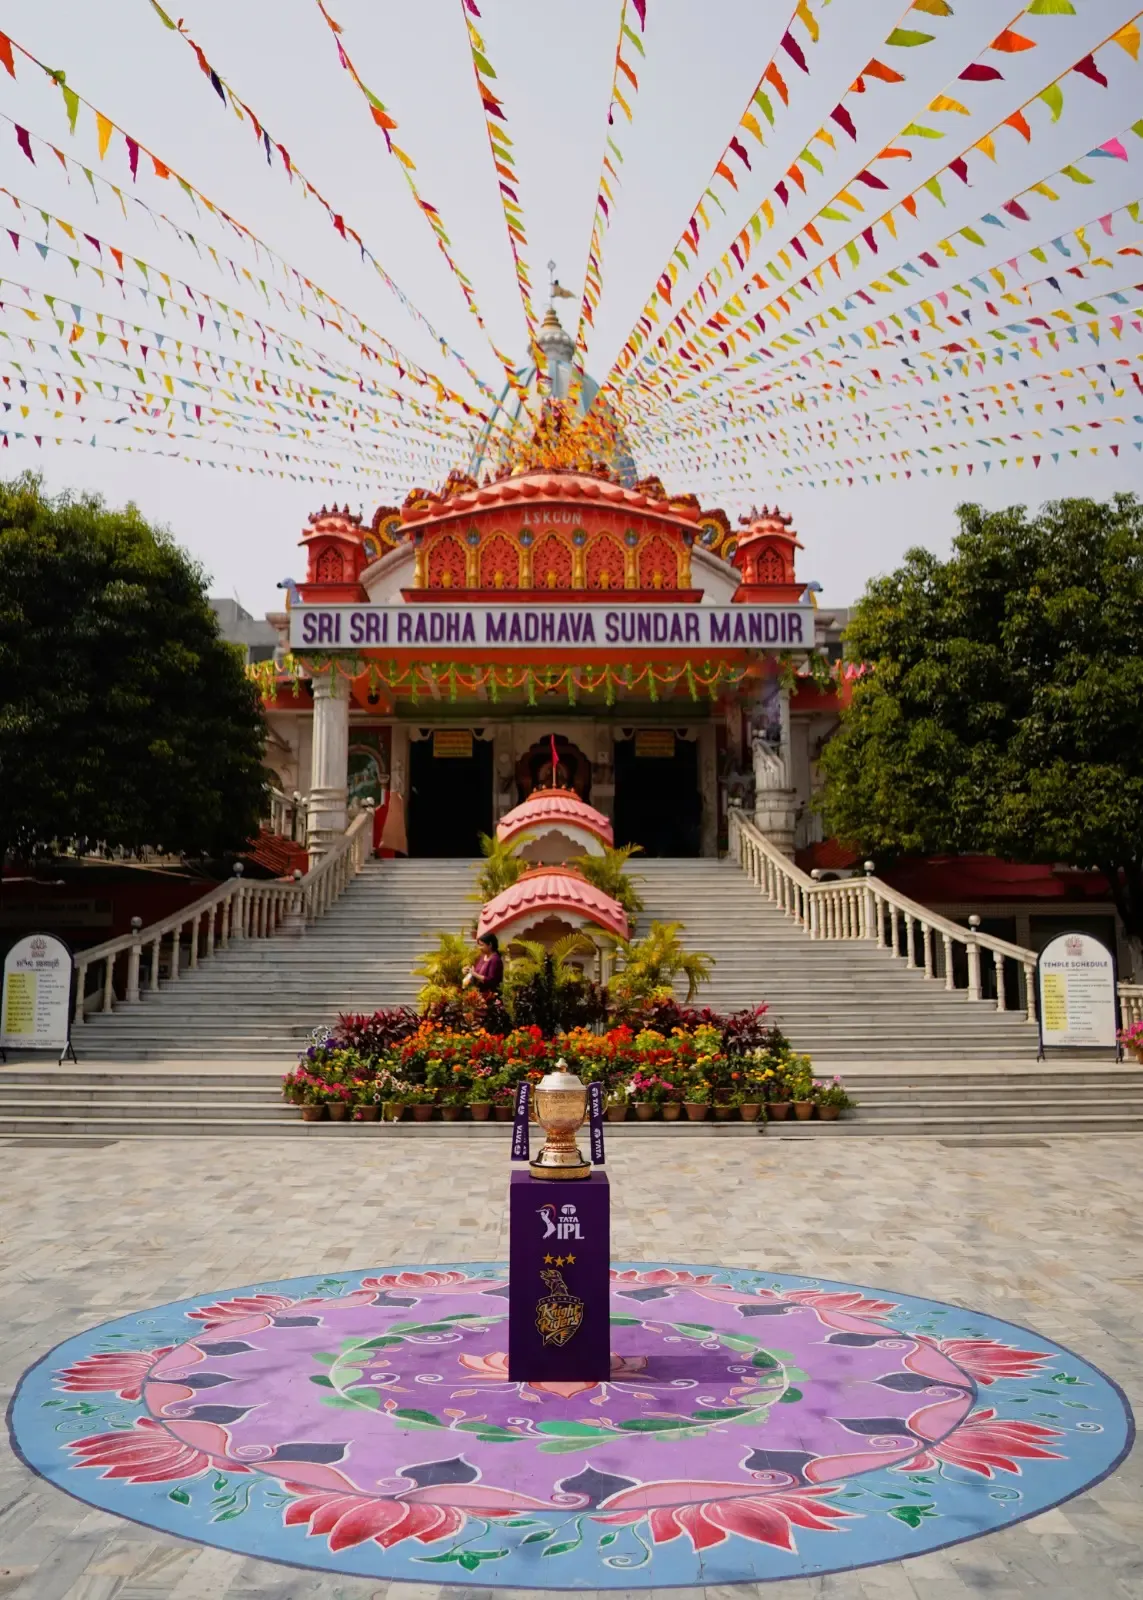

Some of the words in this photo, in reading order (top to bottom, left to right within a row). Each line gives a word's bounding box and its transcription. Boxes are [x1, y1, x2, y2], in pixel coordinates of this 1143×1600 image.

[302, 612, 341, 644] SRI
[350, 612, 389, 644] SRI
[397, 612, 476, 643] RADHA
[485, 612, 596, 643] MADHAVA
[604, 612, 701, 643] SUNDAR
[709, 612, 804, 643] MANDIR
[515, 1125, 523, 1144] TATA
[557, 1223, 585, 1239] IPL
[539, 1303, 581, 1320] Knight
